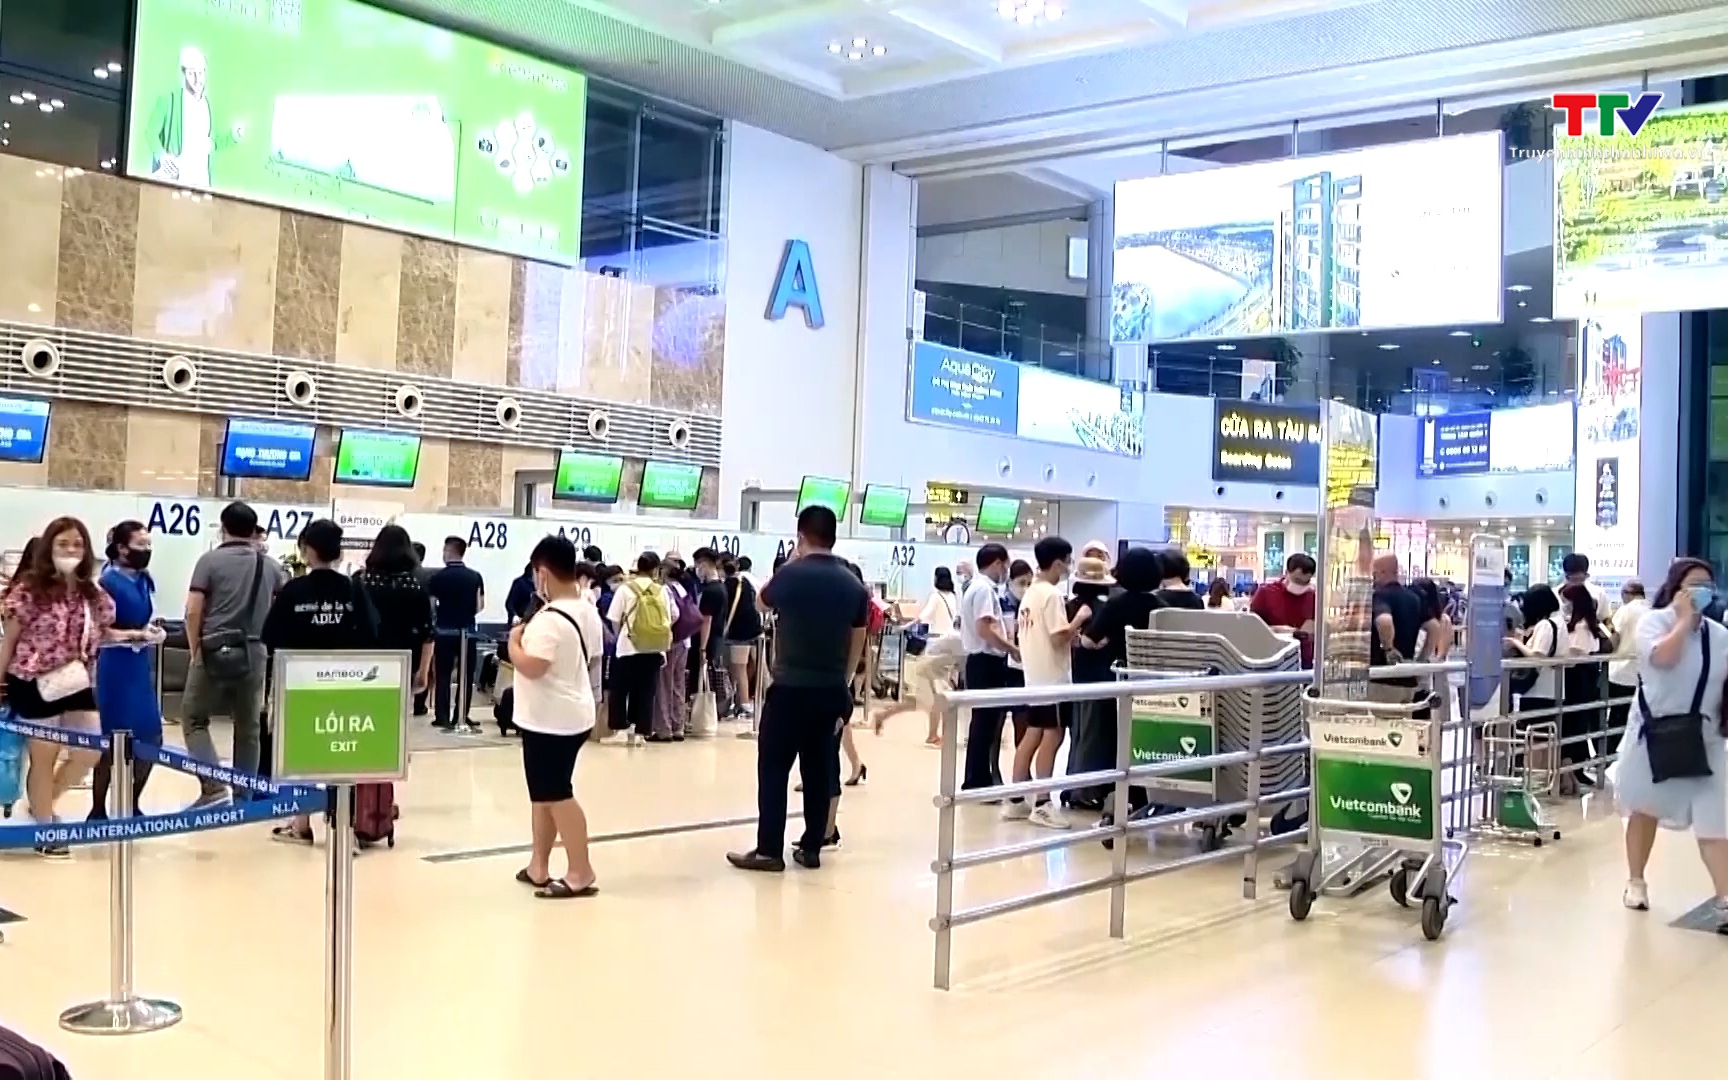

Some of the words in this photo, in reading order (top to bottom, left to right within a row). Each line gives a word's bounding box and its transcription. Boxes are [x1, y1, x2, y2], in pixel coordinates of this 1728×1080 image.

[764, 239, 825, 330] A
[1253, 418, 1274, 440] RA
[1277, 417, 1305, 443] TÀU
[148, 501, 201, 536] A26
[267, 509, 314, 540] A27
[467, 520, 508, 550] A28
[709, 535, 740, 558] A30
[890, 545, 915, 566] A32
[310, 613, 344, 625] ADLV
[348, 715, 375, 732] RA
[329, 740, 358, 752] EXIT
[1323, 733, 1388, 746] Vietcombank
[1329, 795, 1422, 818] Vietcombank
[86, 818, 190, 840] INTERNATIONAL
[194, 808, 246, 829] AIRPORT
